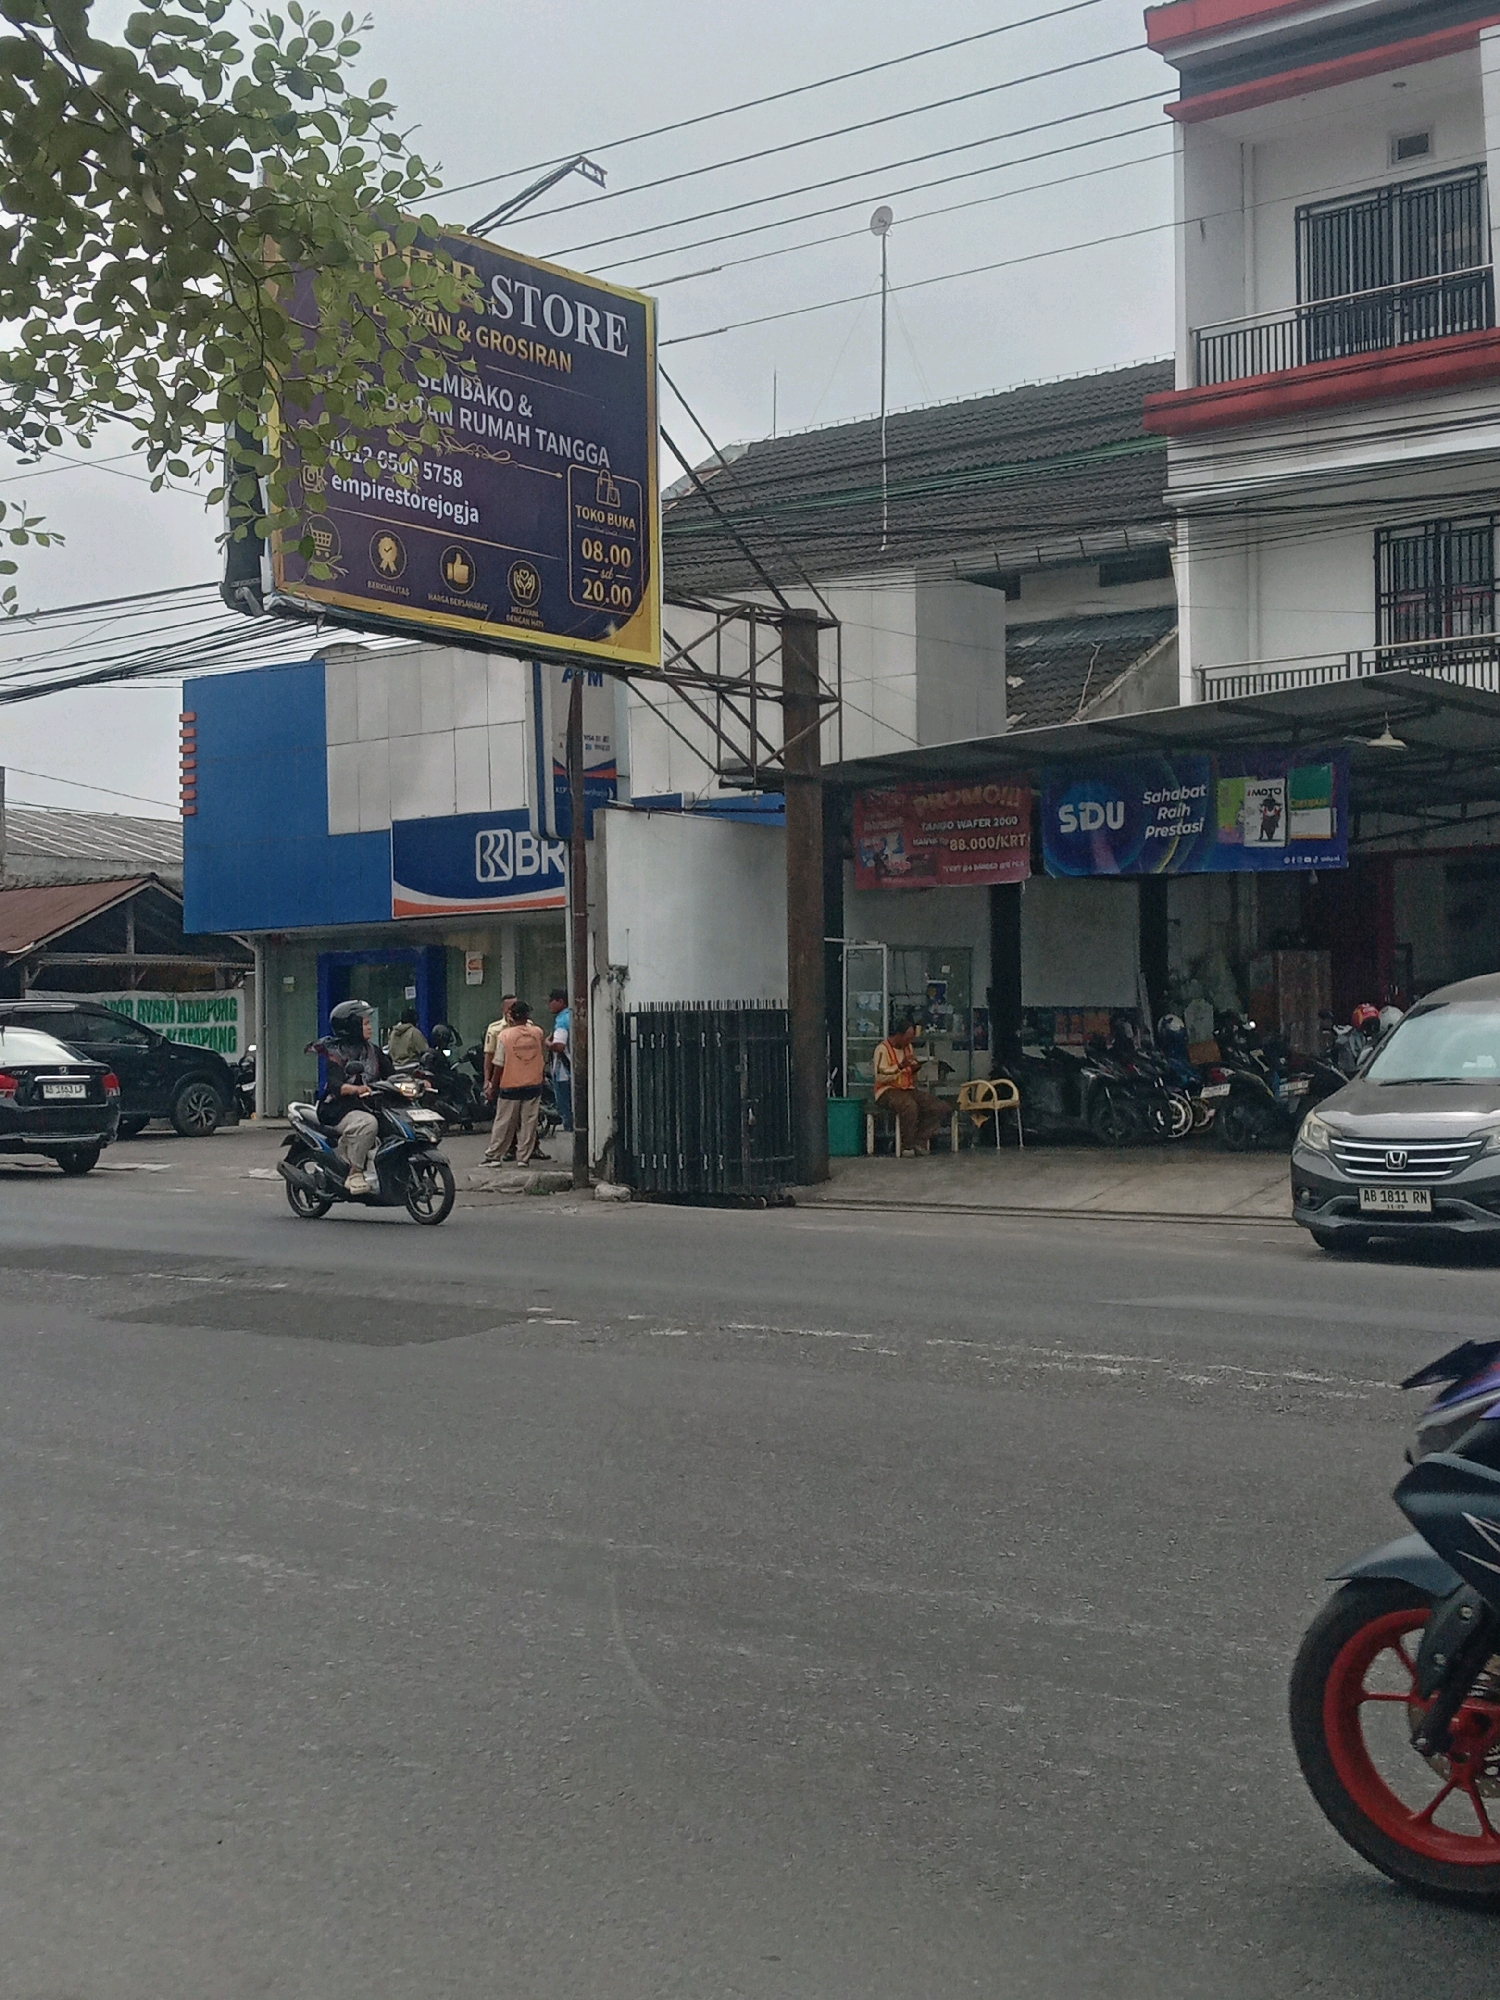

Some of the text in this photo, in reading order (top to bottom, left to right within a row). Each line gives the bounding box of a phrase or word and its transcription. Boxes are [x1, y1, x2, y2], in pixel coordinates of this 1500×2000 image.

[490, 274, 629, 358] STORE
[456, 319, 472, 343] &
[475, 324, 573, 374] GROSIRAN
[417, 369, 534, 418] SEMBAKO &
[459, 407, 531, 448] RUMAH
[535, 428, 611, 469] TANGGA
[423, 462, 464, 488] 5758
[331, 474, 480, 526] empirestorejogja
[575, 505, 636, 532] TOKO BUKA
[581, 537, 632, 568] 08.00
[581, 577, 632, 608] 20.00
[1142, 784, 1207, 805] Sahabat
[956, 819, 991, 829] WAFER
[994, 815, 1018, 826] 2000
[1157, 803, 1191, 820] Raih
[1144, 817, 1205, 840] Prestasi
[136, 998, 175, 1023] AYAM
[1363, 1189, 1427, 1204] AB 1811 RN
